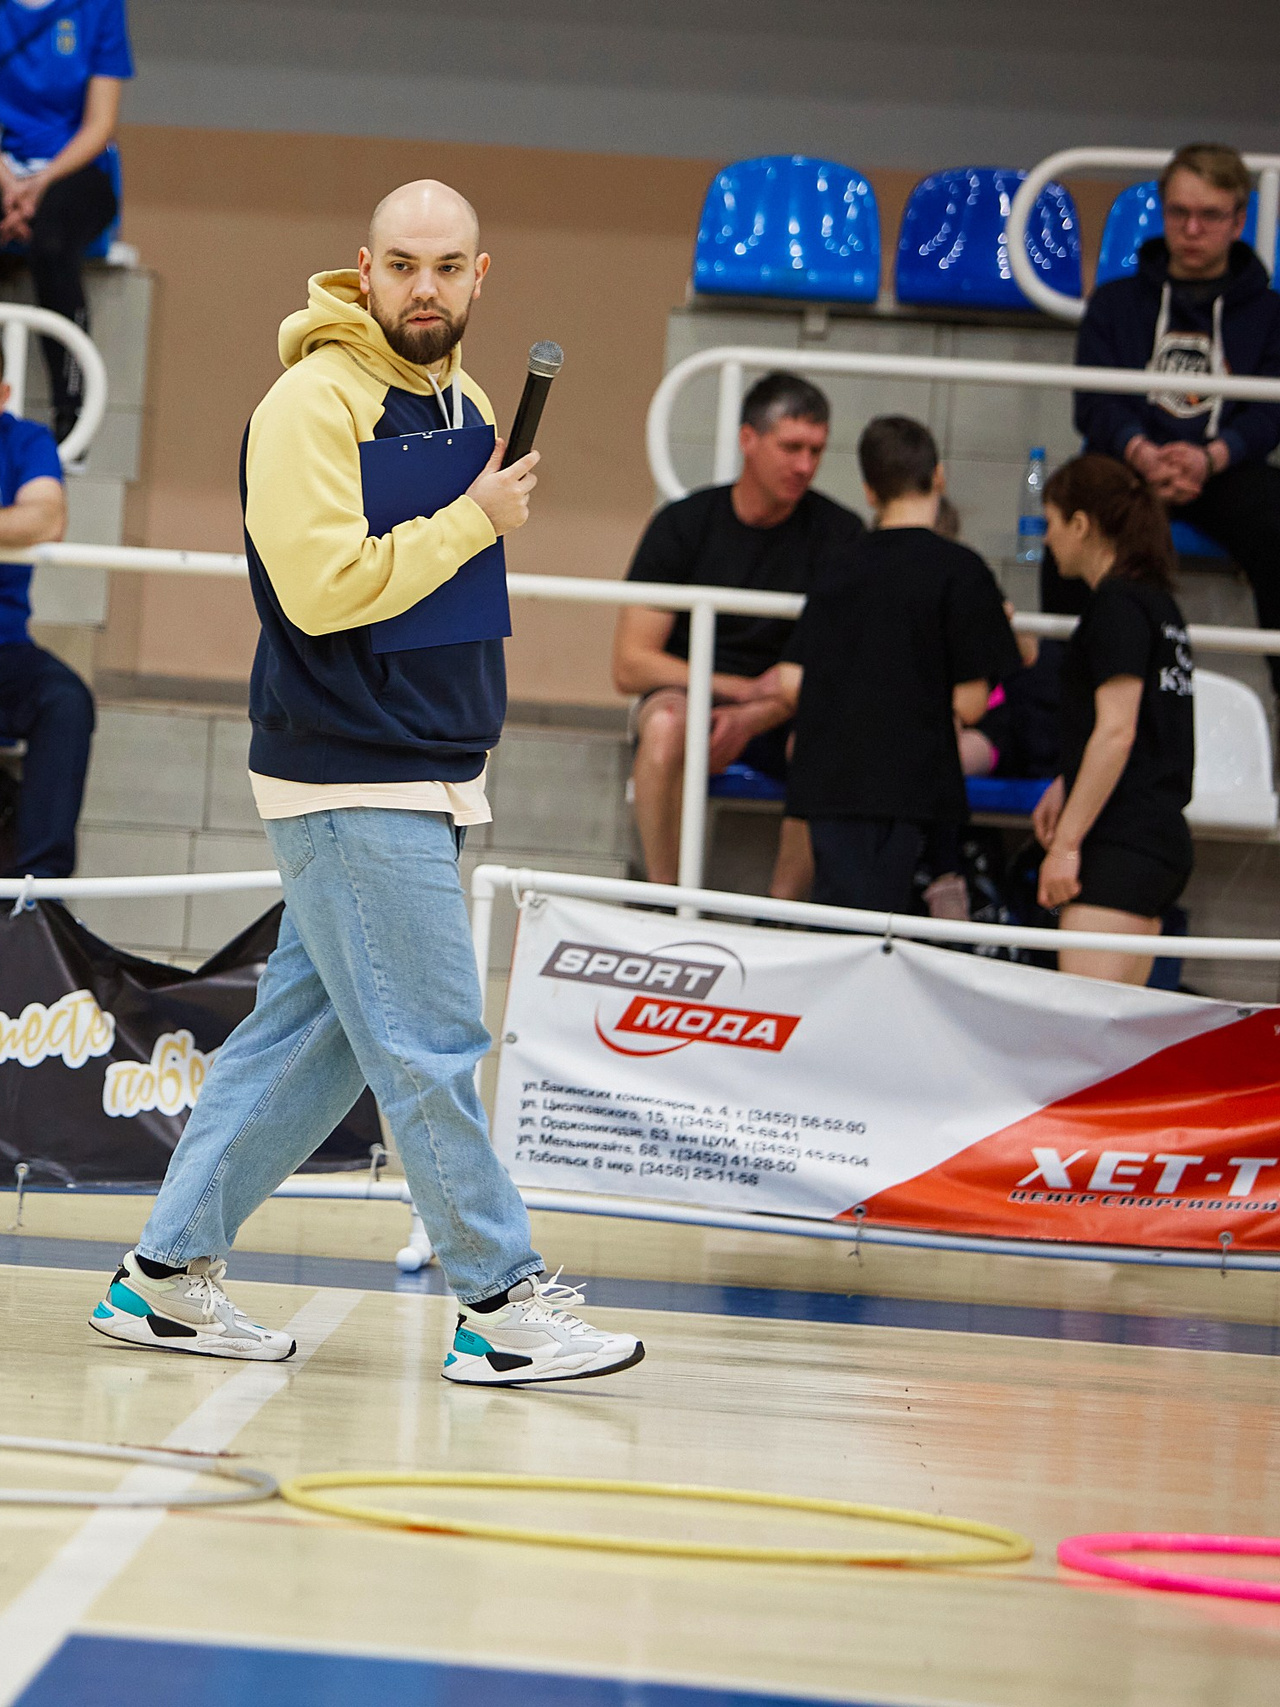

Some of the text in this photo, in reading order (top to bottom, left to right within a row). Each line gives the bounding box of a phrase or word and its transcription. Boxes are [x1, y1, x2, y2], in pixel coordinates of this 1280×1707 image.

[553, 947, 715, 993] SPORT
[632, 1002, 780, 1045] МОДА
[103, 1030, 216, 1117] побе
[1009, 1190, 1096, 1206] ЦЕНТР
